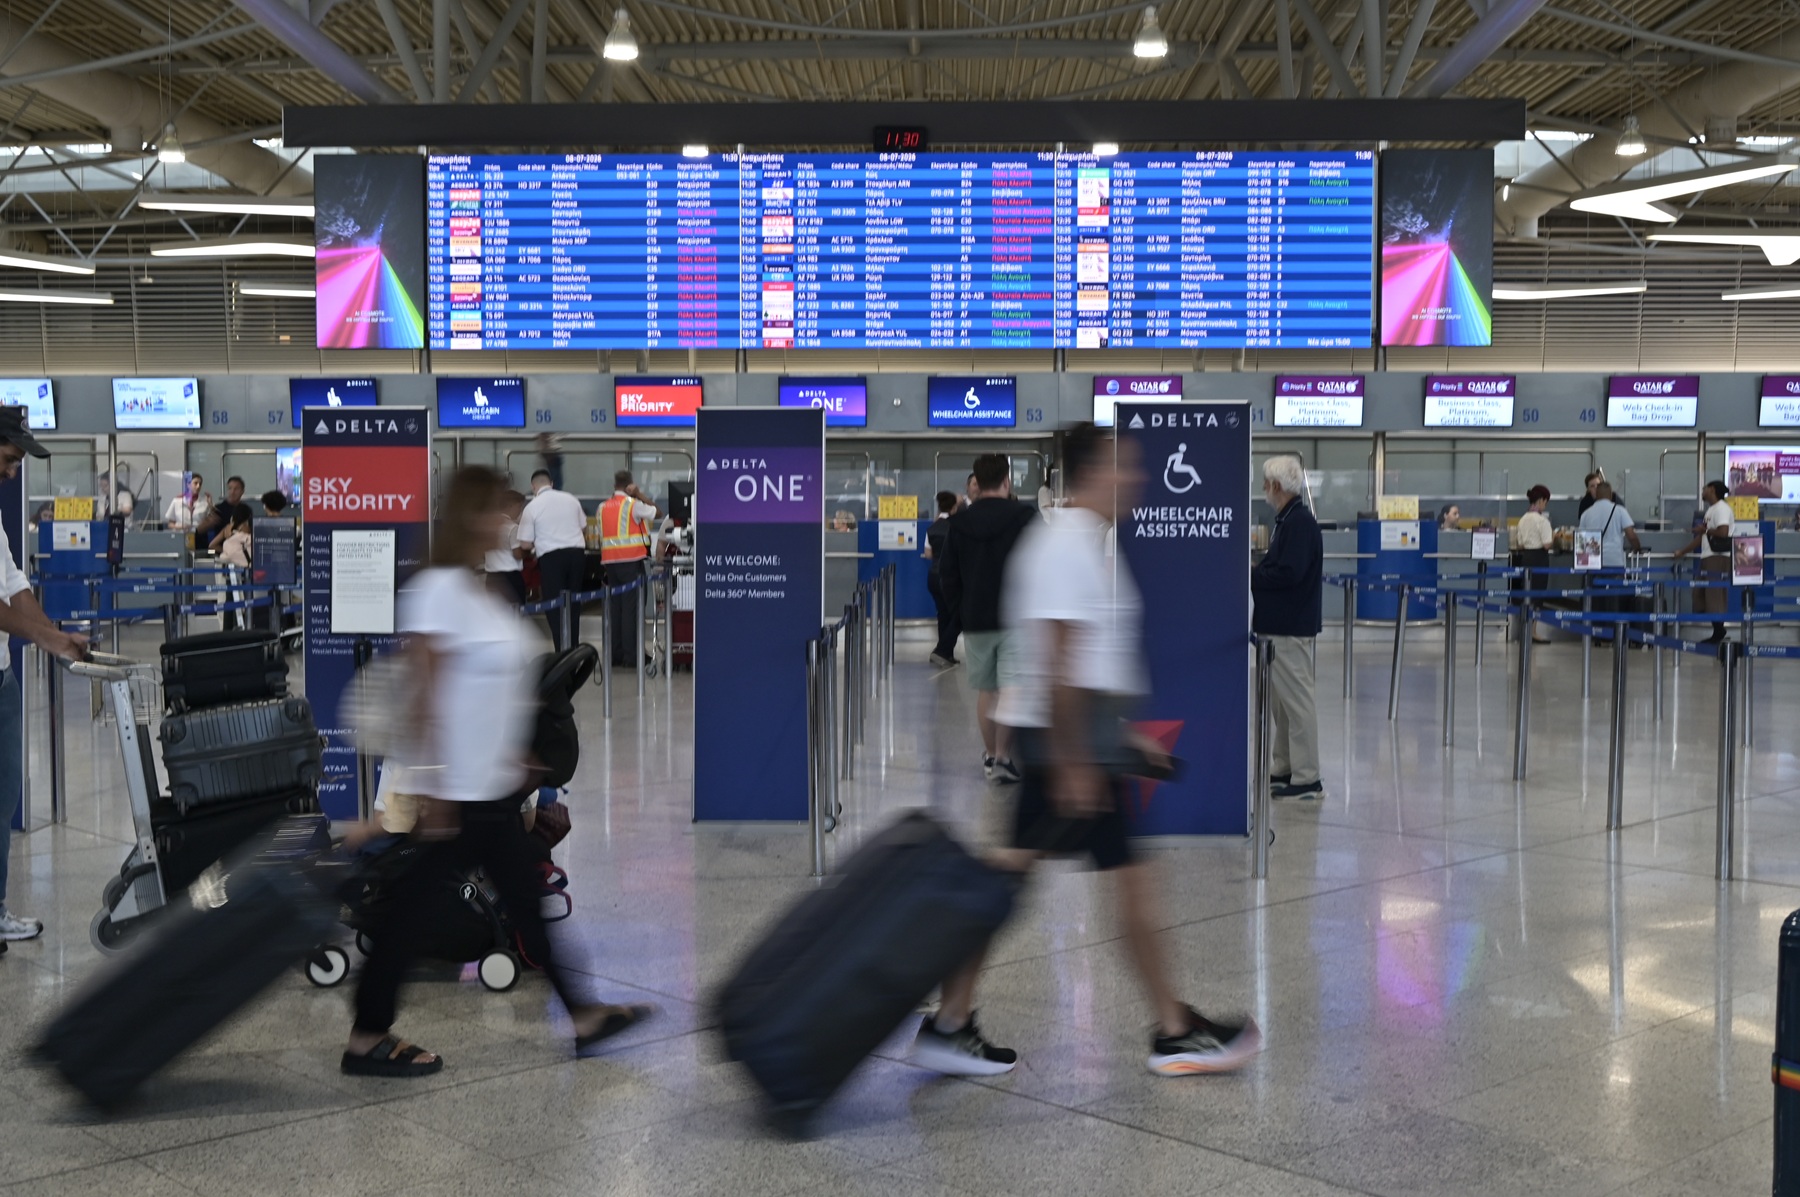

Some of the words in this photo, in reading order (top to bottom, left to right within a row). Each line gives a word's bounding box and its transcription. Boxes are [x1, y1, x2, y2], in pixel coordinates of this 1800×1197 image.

[429, 156, 471, 164] Αναχωρήσεις
[742, 153, 784, 162] Αναχωρήσεις
[1355, 152, 1371, 160] 11:30
[1131, 381, 1158, 392] QATAR
[1317, 381, 1345, 392] QATAR
[1468, 381, 1496, 392] QATAR
[1633, 382, 1662, 392] QATAR
[621, 394, 643, 403] SKY
[621, 402, 673, 412] PRIORITY
[1623, 404, 1642, 412] Web
[212, 410, 229, 425] 58
[268, 410, 284, 424] 57
[536, 409, 552, 424] 56
[591, 409, 606, 423] 55
[933, 410, 973, 419] WHEELCHAIR
[974, 410, 1011, 419] ASSISTANCE
[1027, 409, 1042, 422] 53
[1523, 409, 1539, 423] 50
[1580, 409, 1596, 423] 49
[1151, 413, 1219, 428] DELTA
[336, 419, 399, 434] DELTA
[721, 459, 767, 469] DELTA
[309, 477, 353, 494] SKY
[734, 475, 804, 502] ONE
[309, 494, 412, 510] PRIORITY
[1132, 507, 1233, 521] WHEELCHAIR
[1135, 523, 1230, 538] ASSISTANCE
[310, 534, 326, 542] Delta
[706, 556, 722, 565] WE
[725, 556, 780, 566] WELCOME:
[706, 573, 726, 582] Delta
[727, 573, 744, 582] One
[745, 573, 787, 583] Customers
[706, 589, 726, 598] Delta
[748, 589, 785, 598] Members
[312, 605, 323, 613] WE
